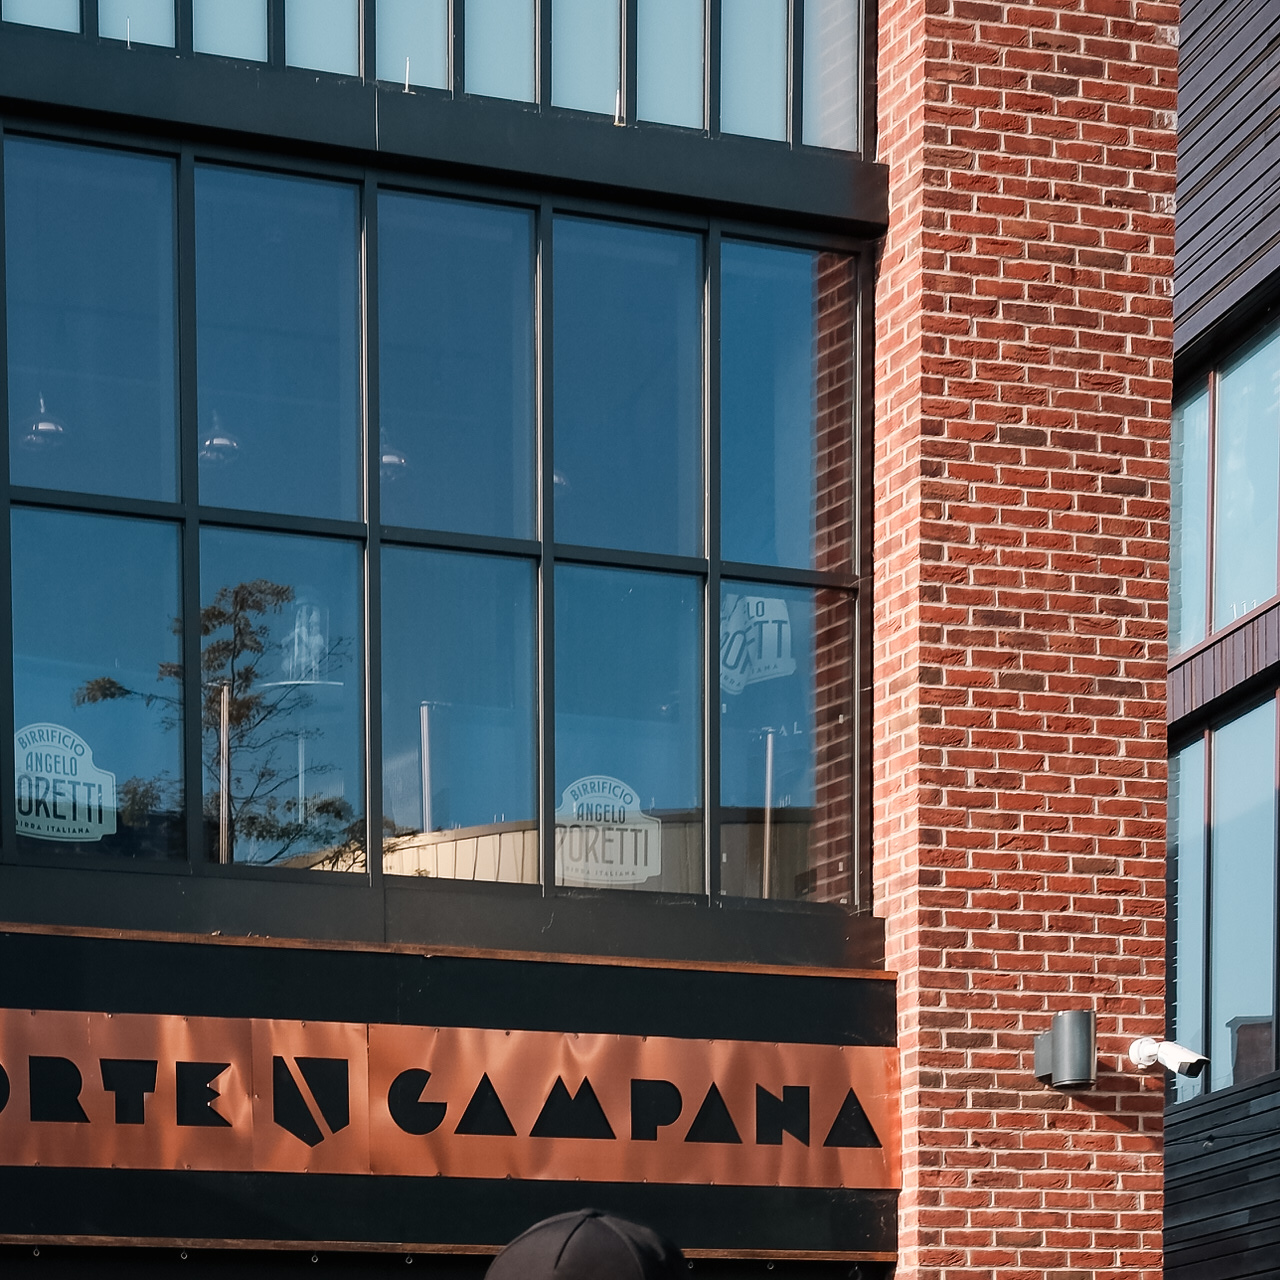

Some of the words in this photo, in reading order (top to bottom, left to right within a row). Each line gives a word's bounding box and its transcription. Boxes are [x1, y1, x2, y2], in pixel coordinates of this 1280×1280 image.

[17, 729, 85, 757] BIRRIFICIO
[25, 751, 77, 777] ANGELO
[570, 780, 634, 806] BIRRIFICIO
[577, 802, 625, 824] ANGELO
[46, 825, 90, 834] ITALIANA
